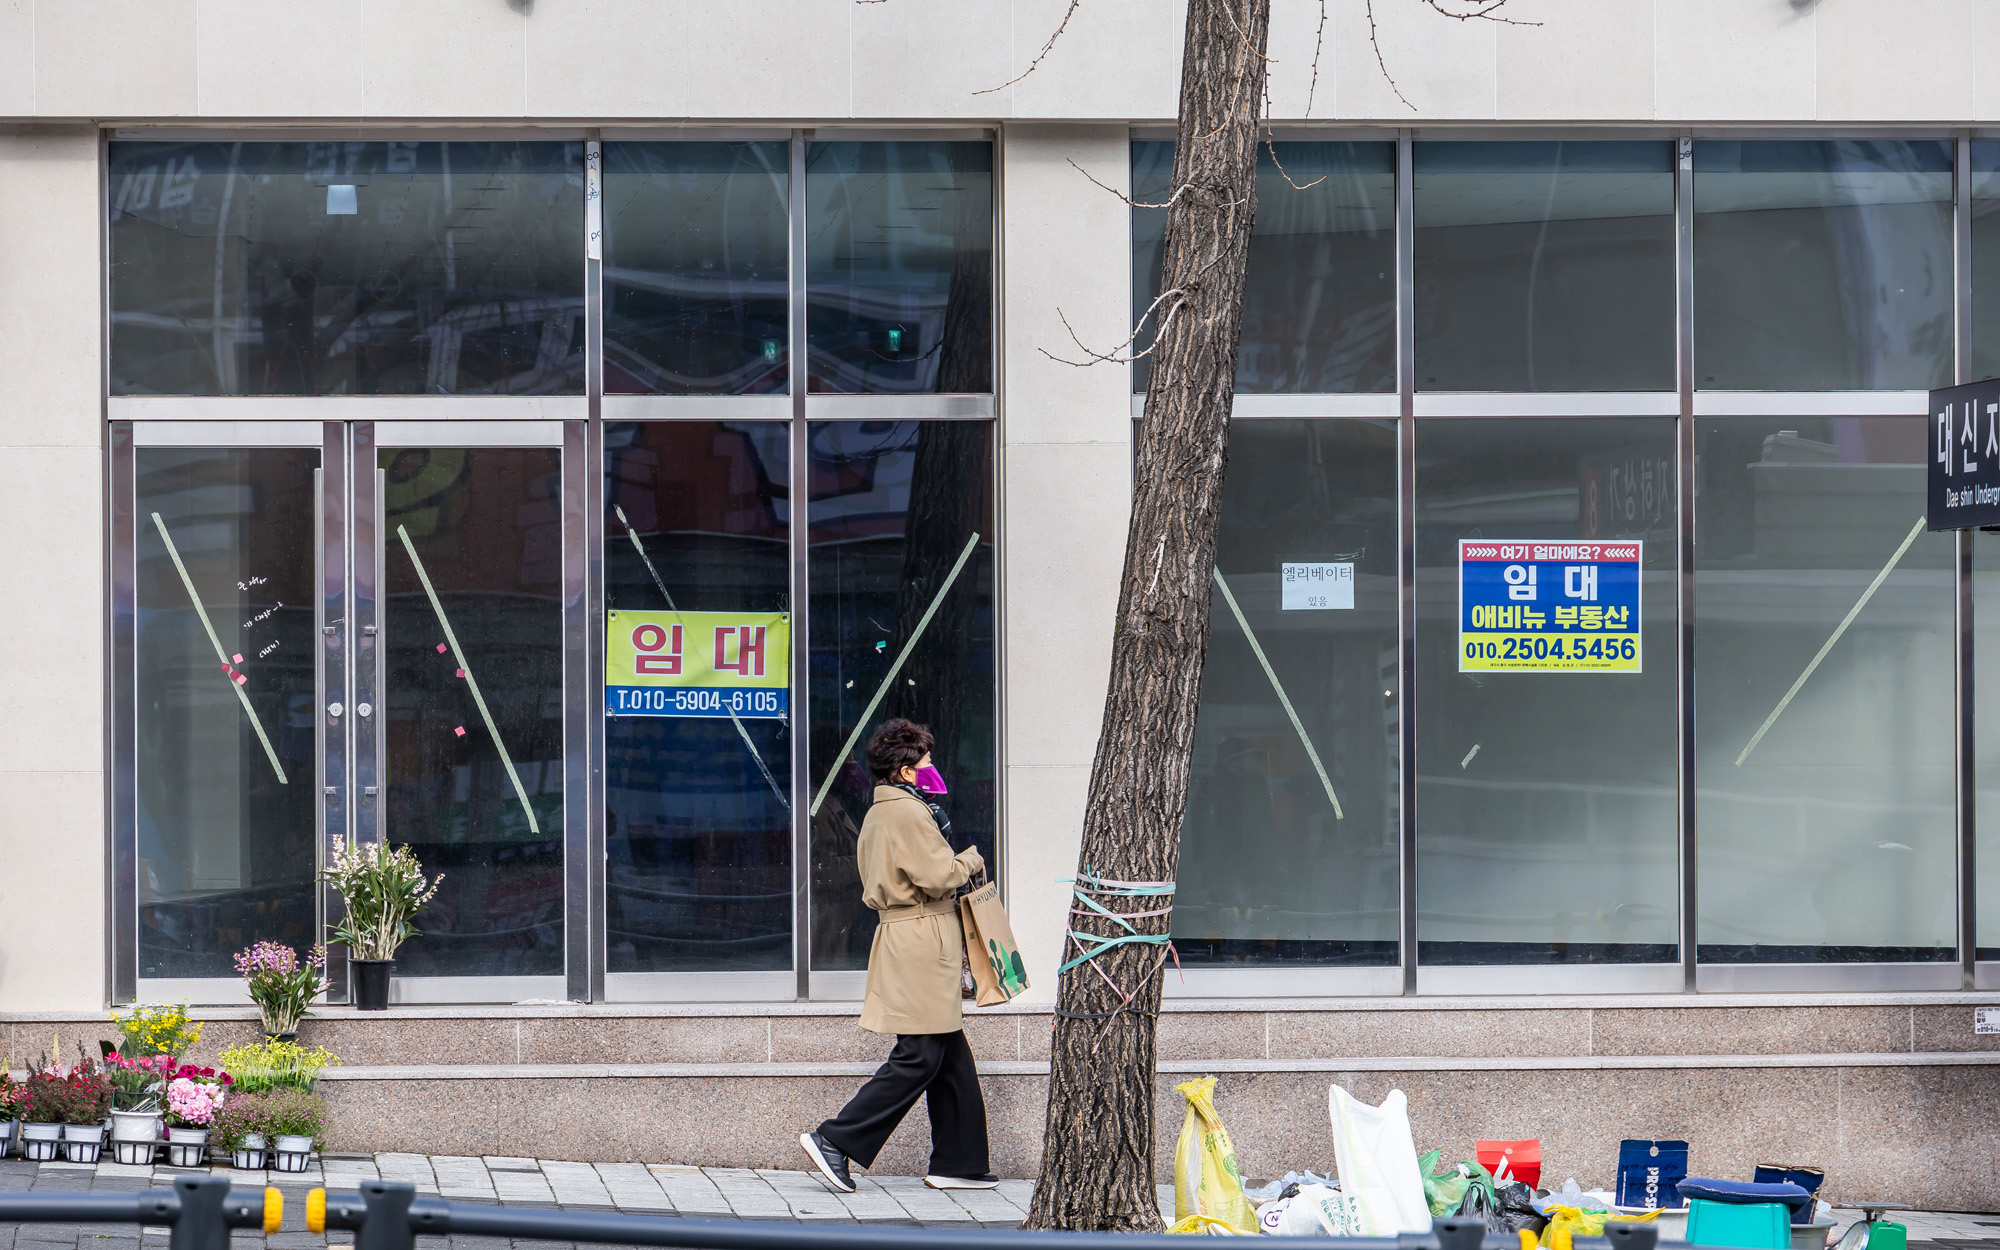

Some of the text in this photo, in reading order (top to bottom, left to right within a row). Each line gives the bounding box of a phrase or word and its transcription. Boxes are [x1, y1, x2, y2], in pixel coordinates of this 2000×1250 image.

[1946, 488, 1958, 508] Dae
[1960, 486, 1973, 505] shin
[1500, 545, 1601, 560] 여기 얼마에요?
[1282, 566, 1352, 581] 엘리베이터
[1503, 565, 1598, 601] 임 대
[1308, 596, 1328, 607] 있음
[1471, 605, 1629, 630] 애비뉴 부동산
[631, 622, 766, 677] 임 대
[1466, 637, 1636, 660] 010.2504.5456
[617, 689, 778, 712] T.010-5904-6105
